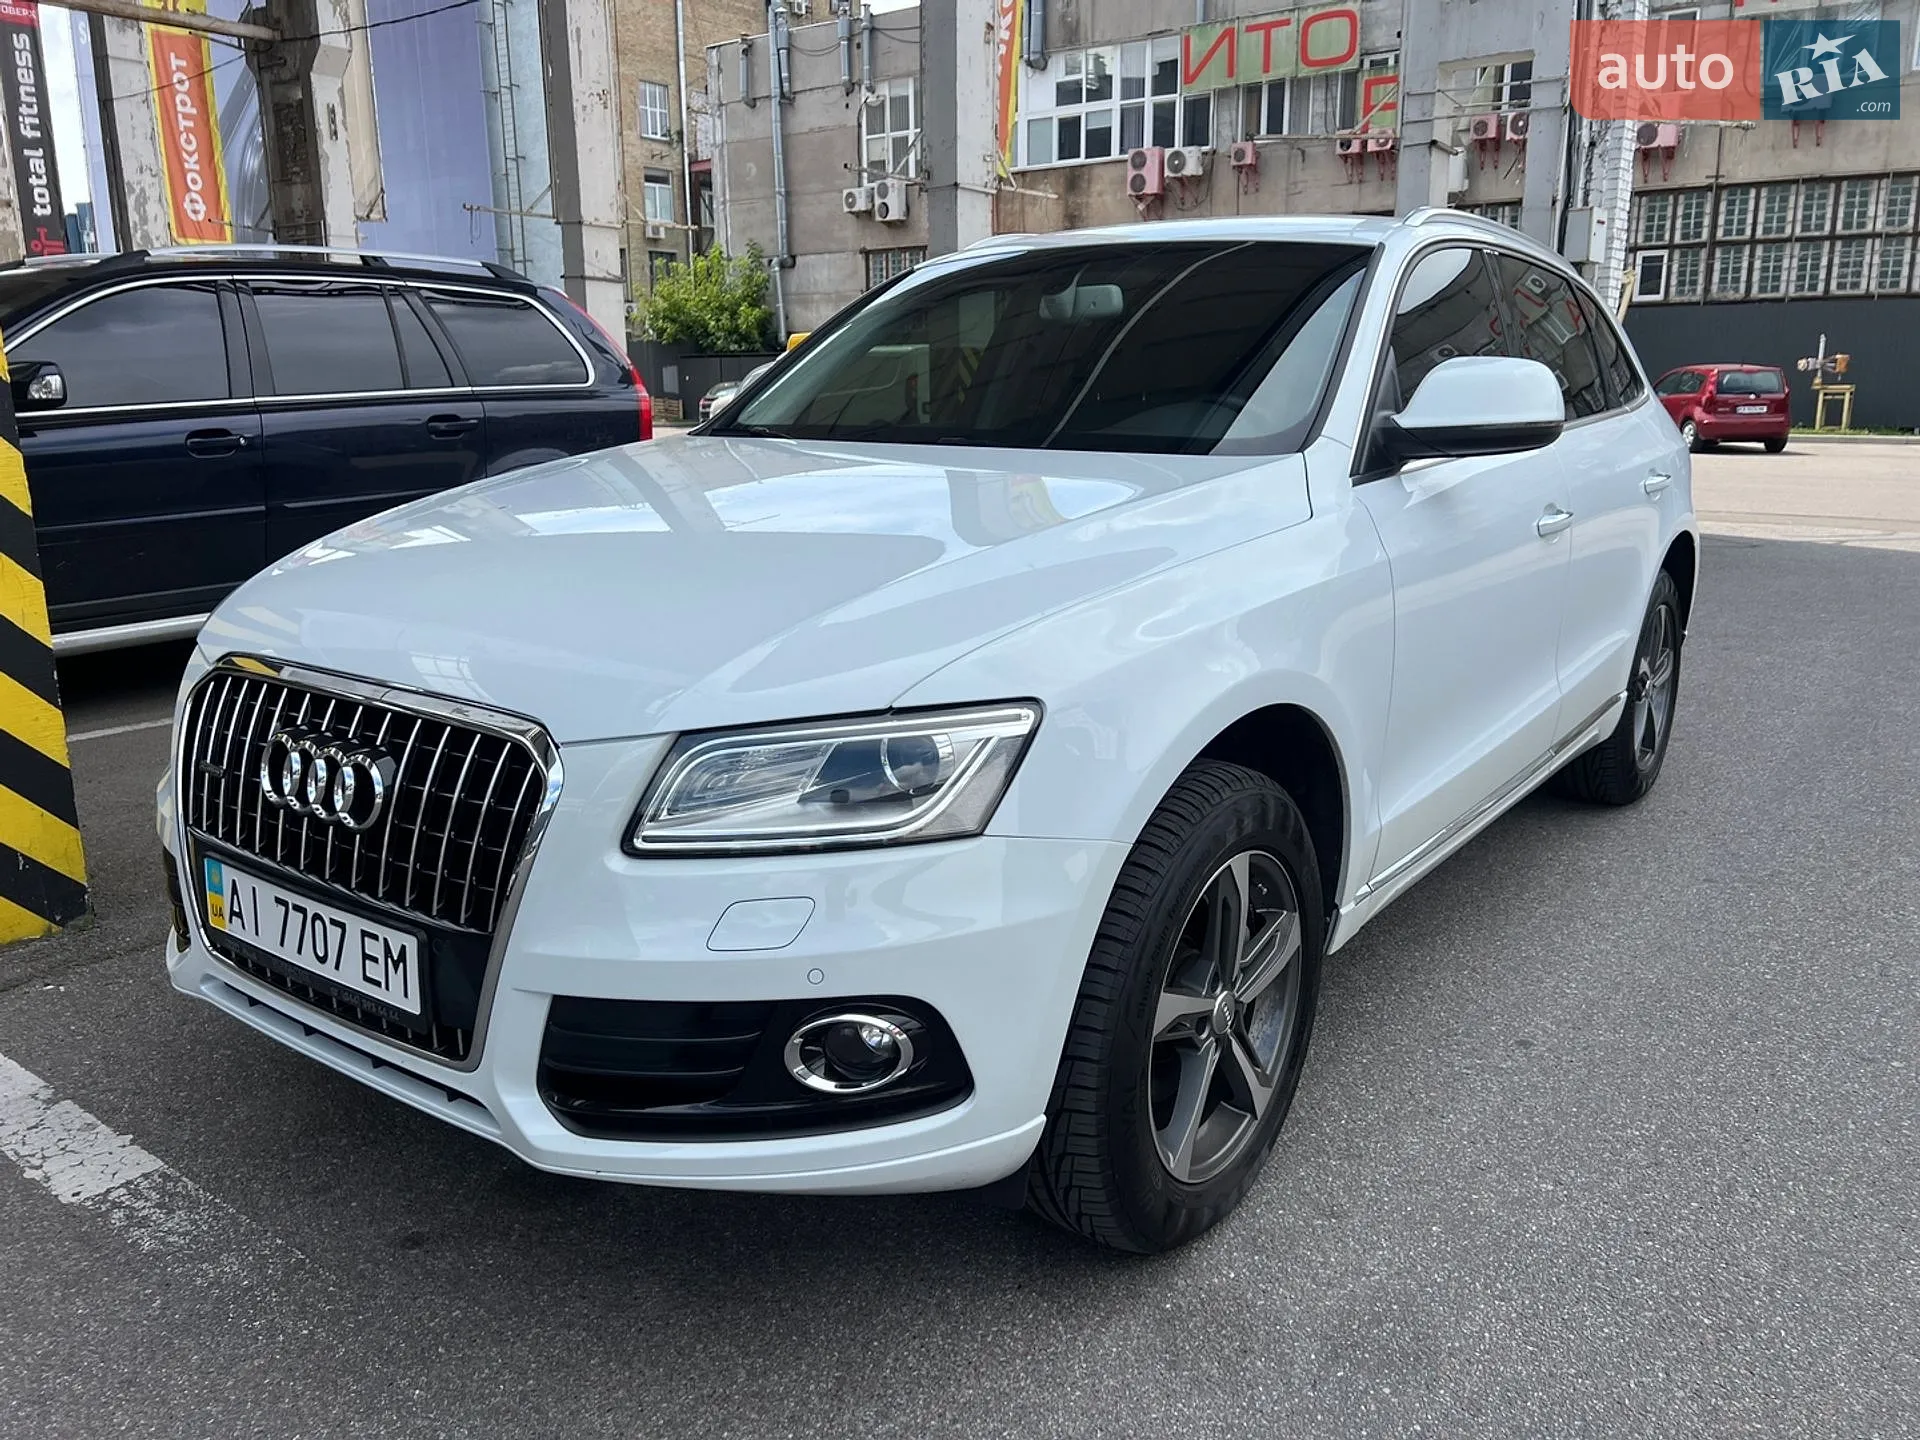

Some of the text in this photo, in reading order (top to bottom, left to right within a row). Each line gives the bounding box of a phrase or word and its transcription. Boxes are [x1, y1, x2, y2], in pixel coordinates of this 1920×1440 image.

[12, 33, 52, 216] total fitness
[211, 904, 225, 920] UA
[229, 878, 259, 937] AI
[274, 895, 347, 971] 7707
[359, 928, 409, 999] EM
